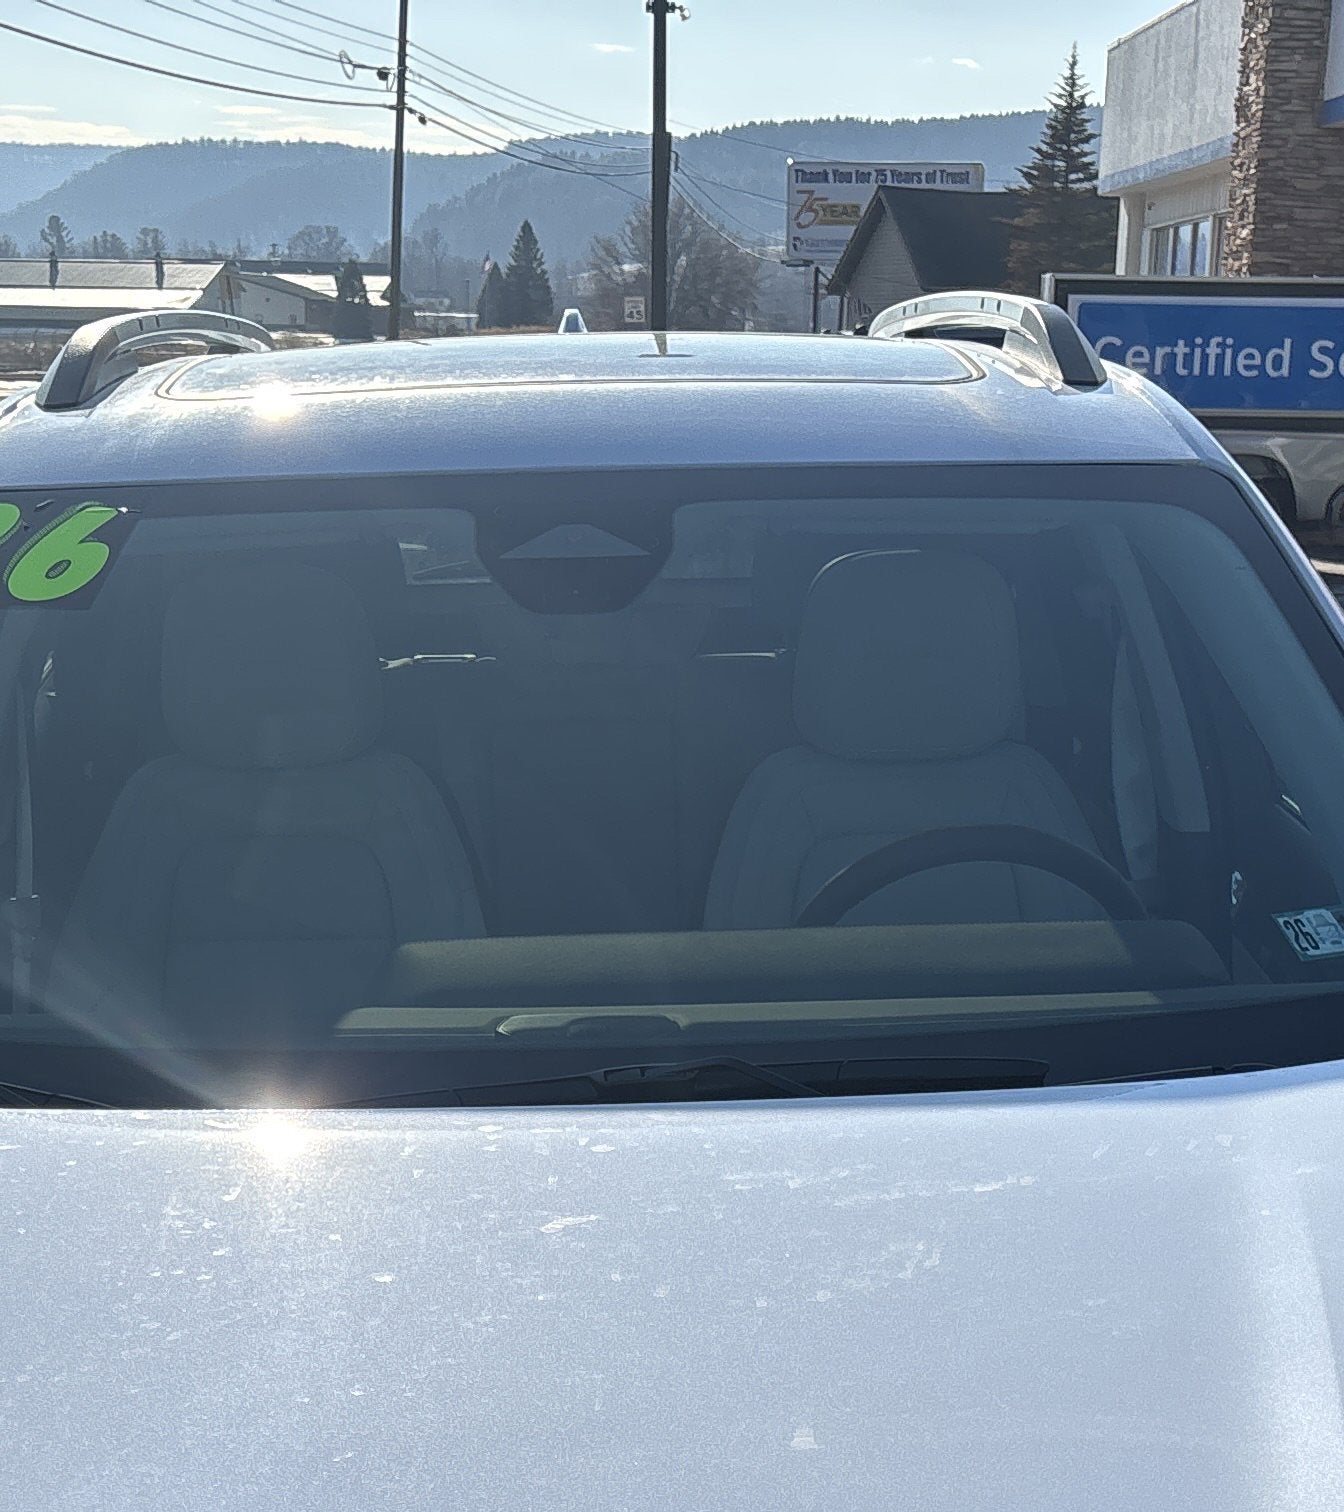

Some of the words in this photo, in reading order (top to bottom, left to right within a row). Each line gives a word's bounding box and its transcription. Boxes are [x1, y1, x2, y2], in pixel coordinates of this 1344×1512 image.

[794, 168, 829, 184] Thank
[832, 168, 853, 184] You
[855, 169, 872, 184] for
[874, 169, 887, 184] 75
[889, 169, 922, 184] Years
[925, 169, 937, 184] of
[939, 169, 970, 184] Trust
[626, 310, 643, 320] 45
[1094, 336, 1292, 378] Certified
[1282, 918, 1321, 952] 26
